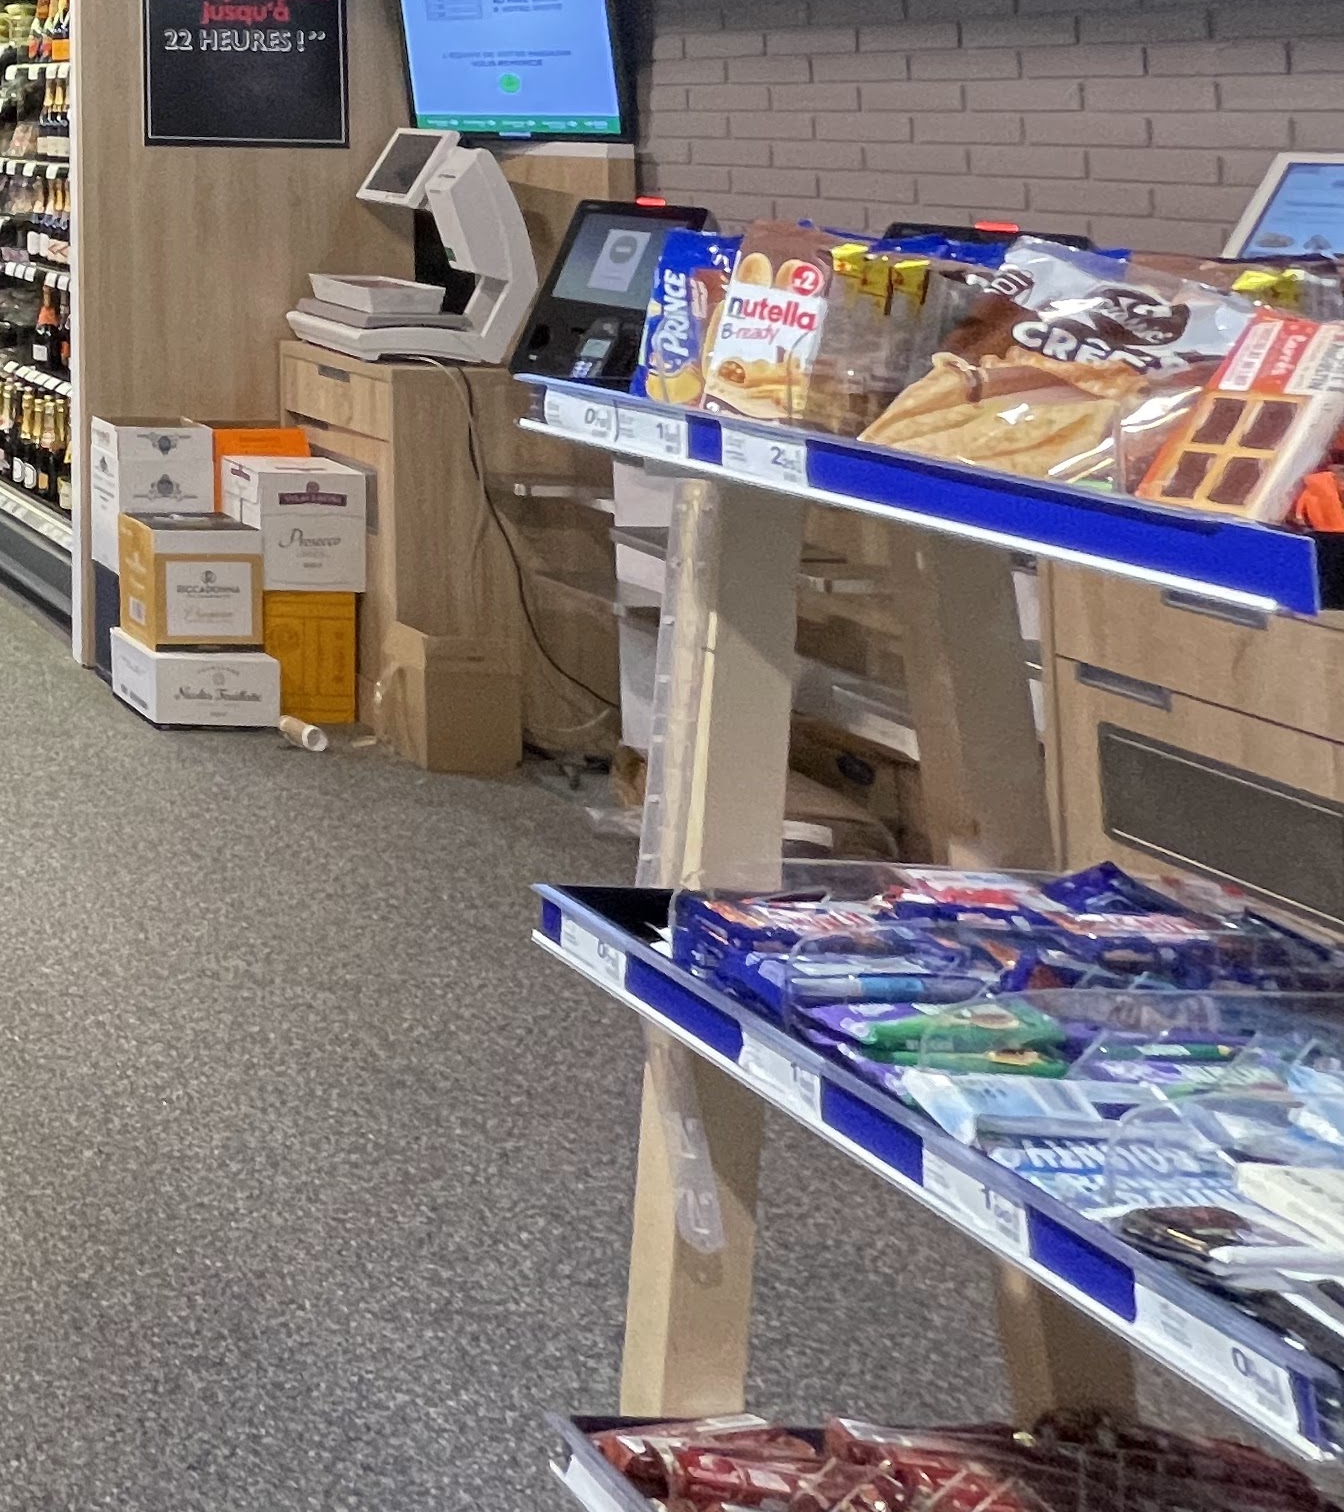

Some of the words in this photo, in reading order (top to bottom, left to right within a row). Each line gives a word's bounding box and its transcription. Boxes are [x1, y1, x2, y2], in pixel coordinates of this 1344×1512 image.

[164, 28, 193, 51] 22
[199, 28, 292, 53] HEURES
[663, 269, 690, 358] PRINCE
[727, 296, 818, 332] nutella
[721, 323, 780, 345] B-ready
